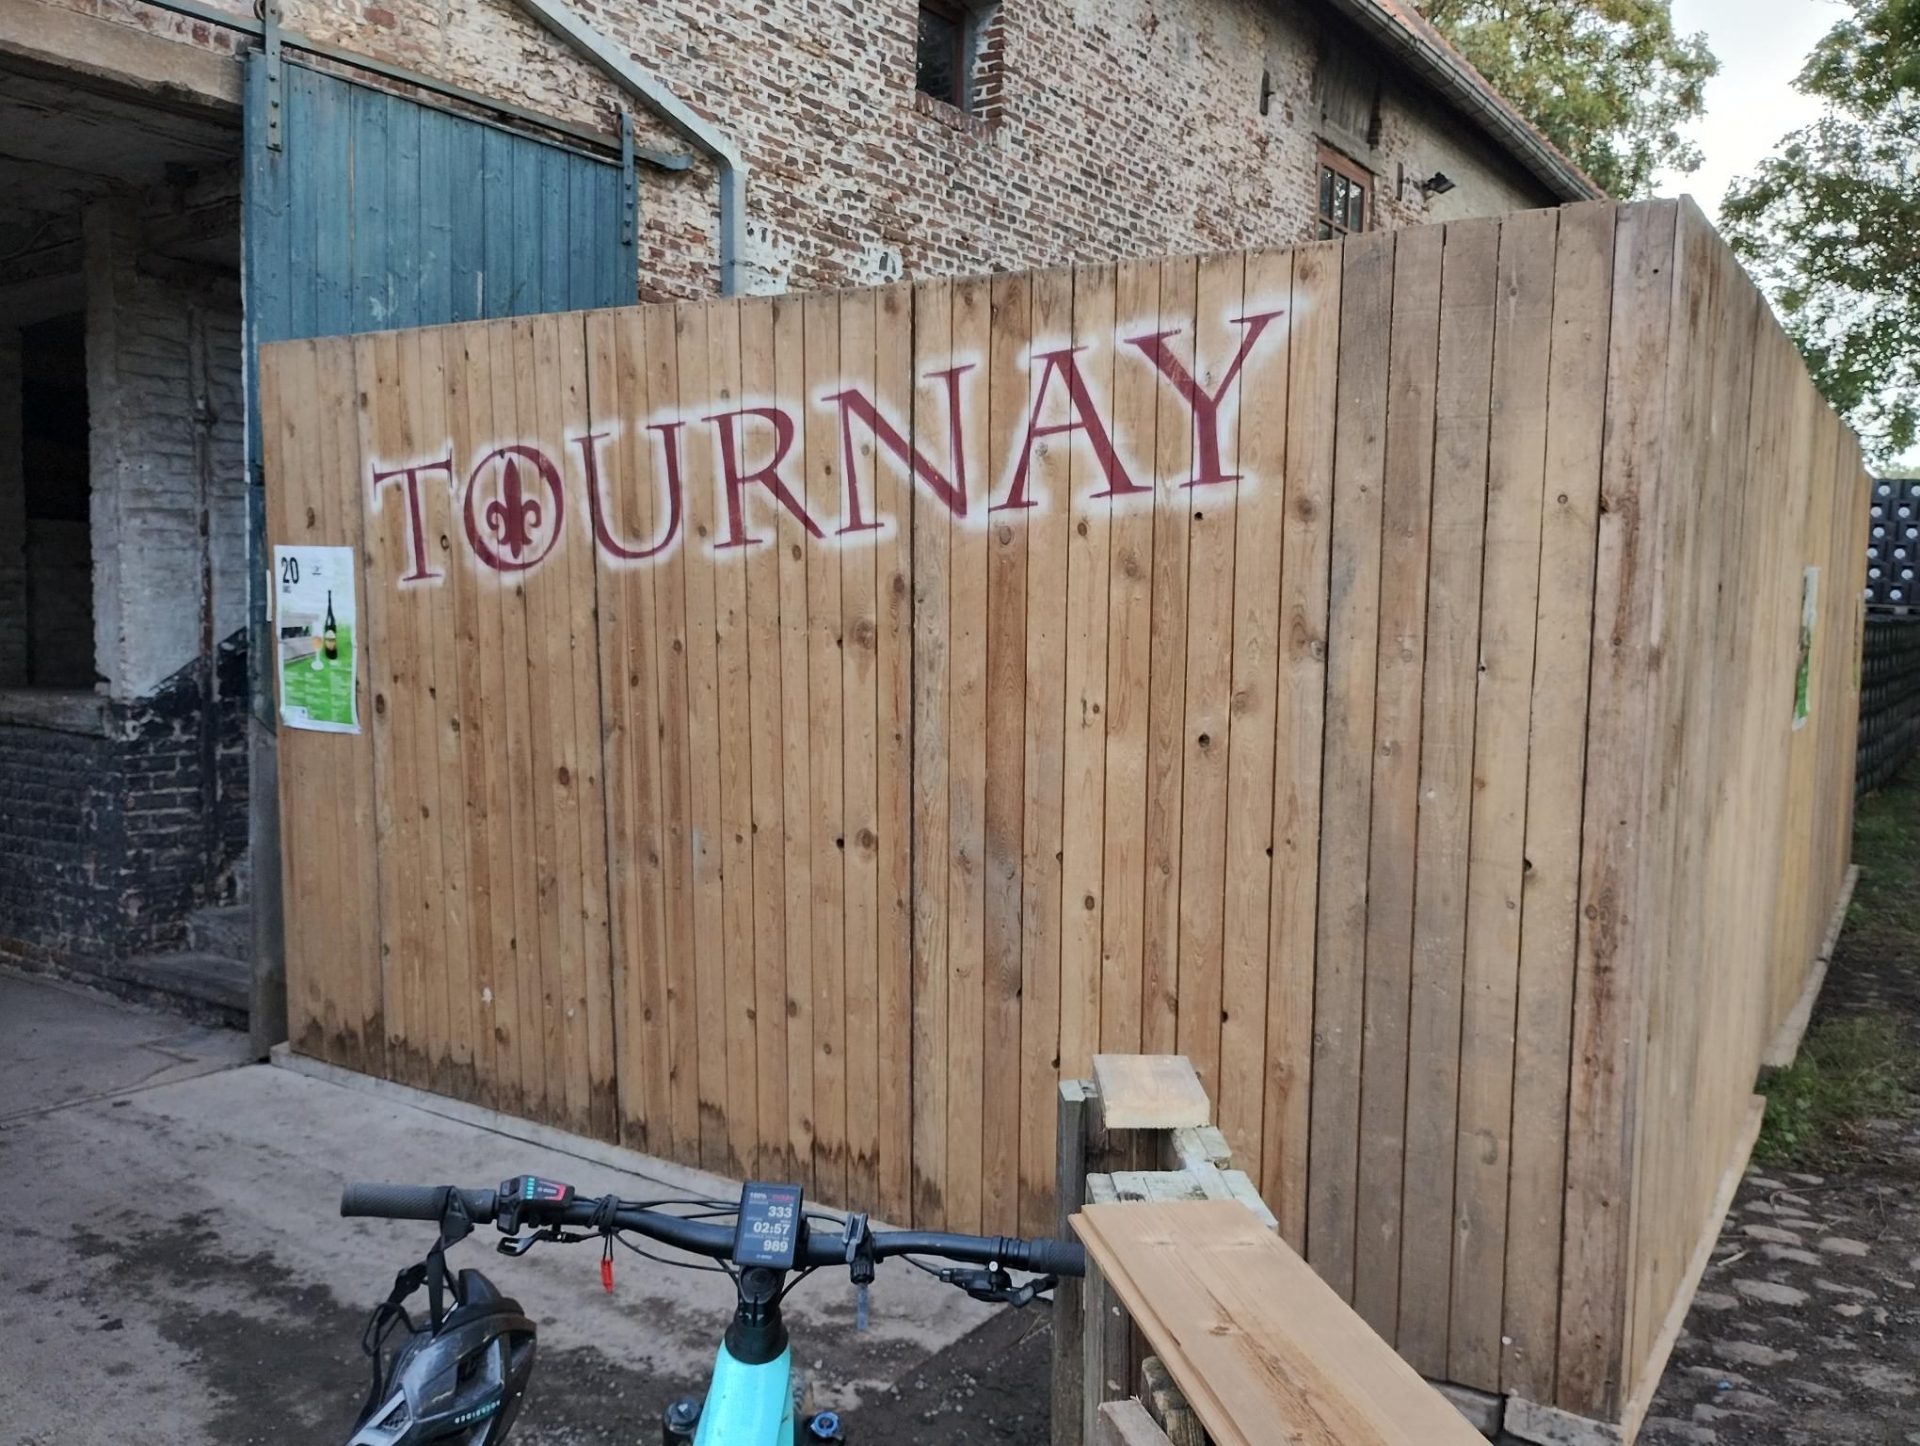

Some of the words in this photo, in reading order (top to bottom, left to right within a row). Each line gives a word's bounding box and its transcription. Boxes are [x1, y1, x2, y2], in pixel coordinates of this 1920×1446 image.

[372, 309, 1286, 582] TOURNAY
[281, 556, 300, 585] 20
[768, 1206, 792, 1218] 333
[753, 1222, 790, 1235] 02:57
